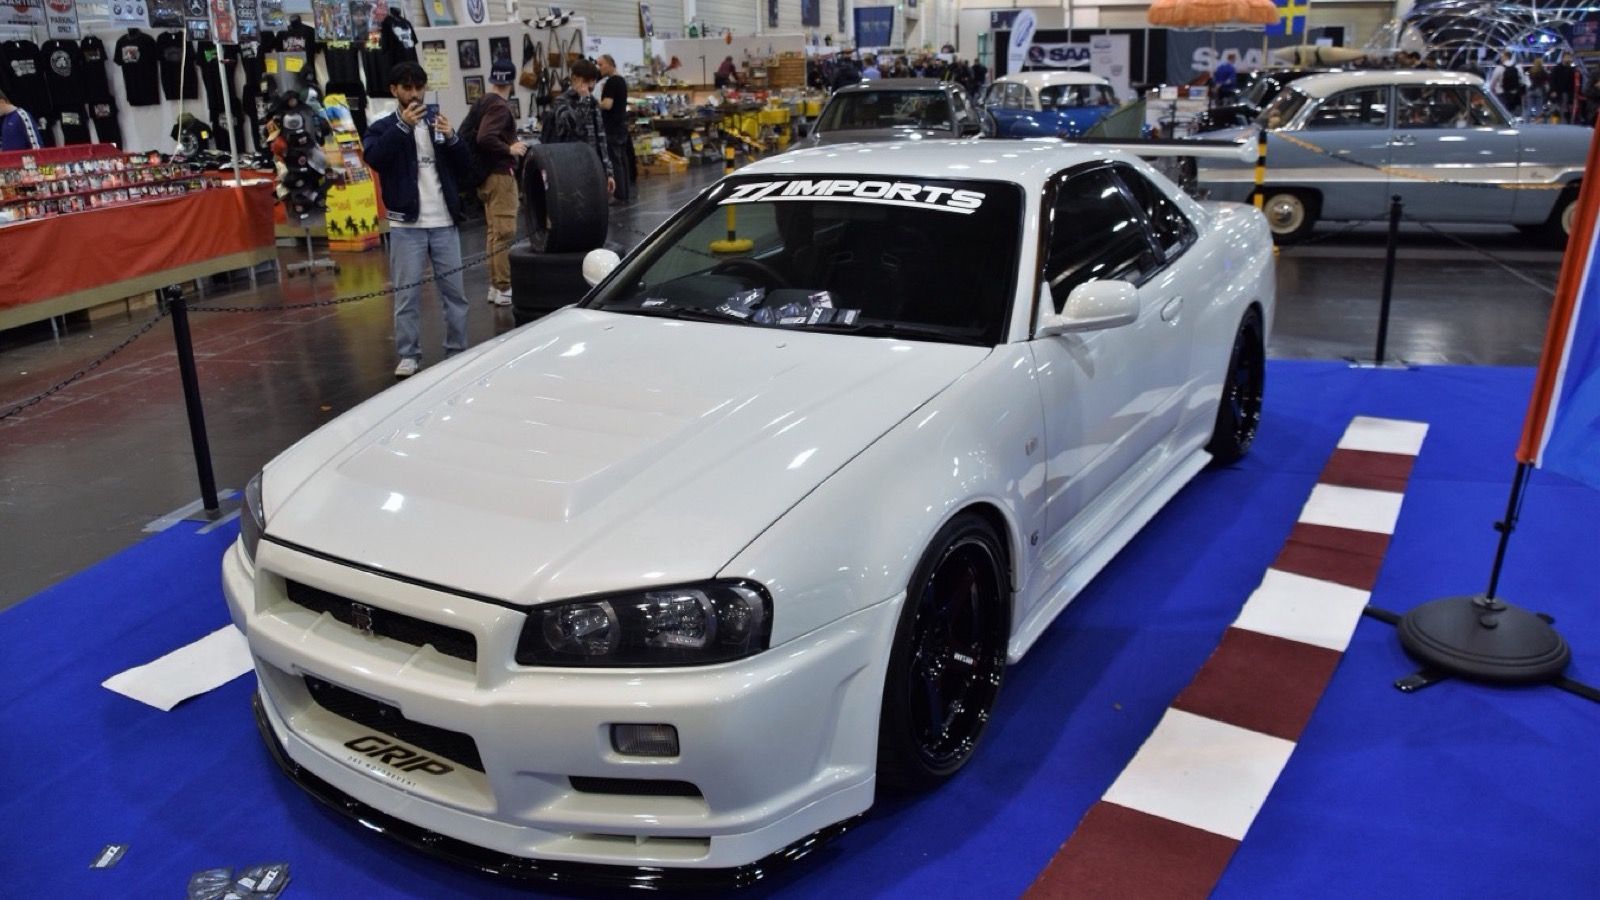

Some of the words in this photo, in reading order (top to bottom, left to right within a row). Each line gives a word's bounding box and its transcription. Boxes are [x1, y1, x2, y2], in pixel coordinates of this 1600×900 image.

[1049, 47, 1091, 61] SAA
[782, 180, 986, 210] IMPORTS
[344, 736, 454, 775] GRIP
